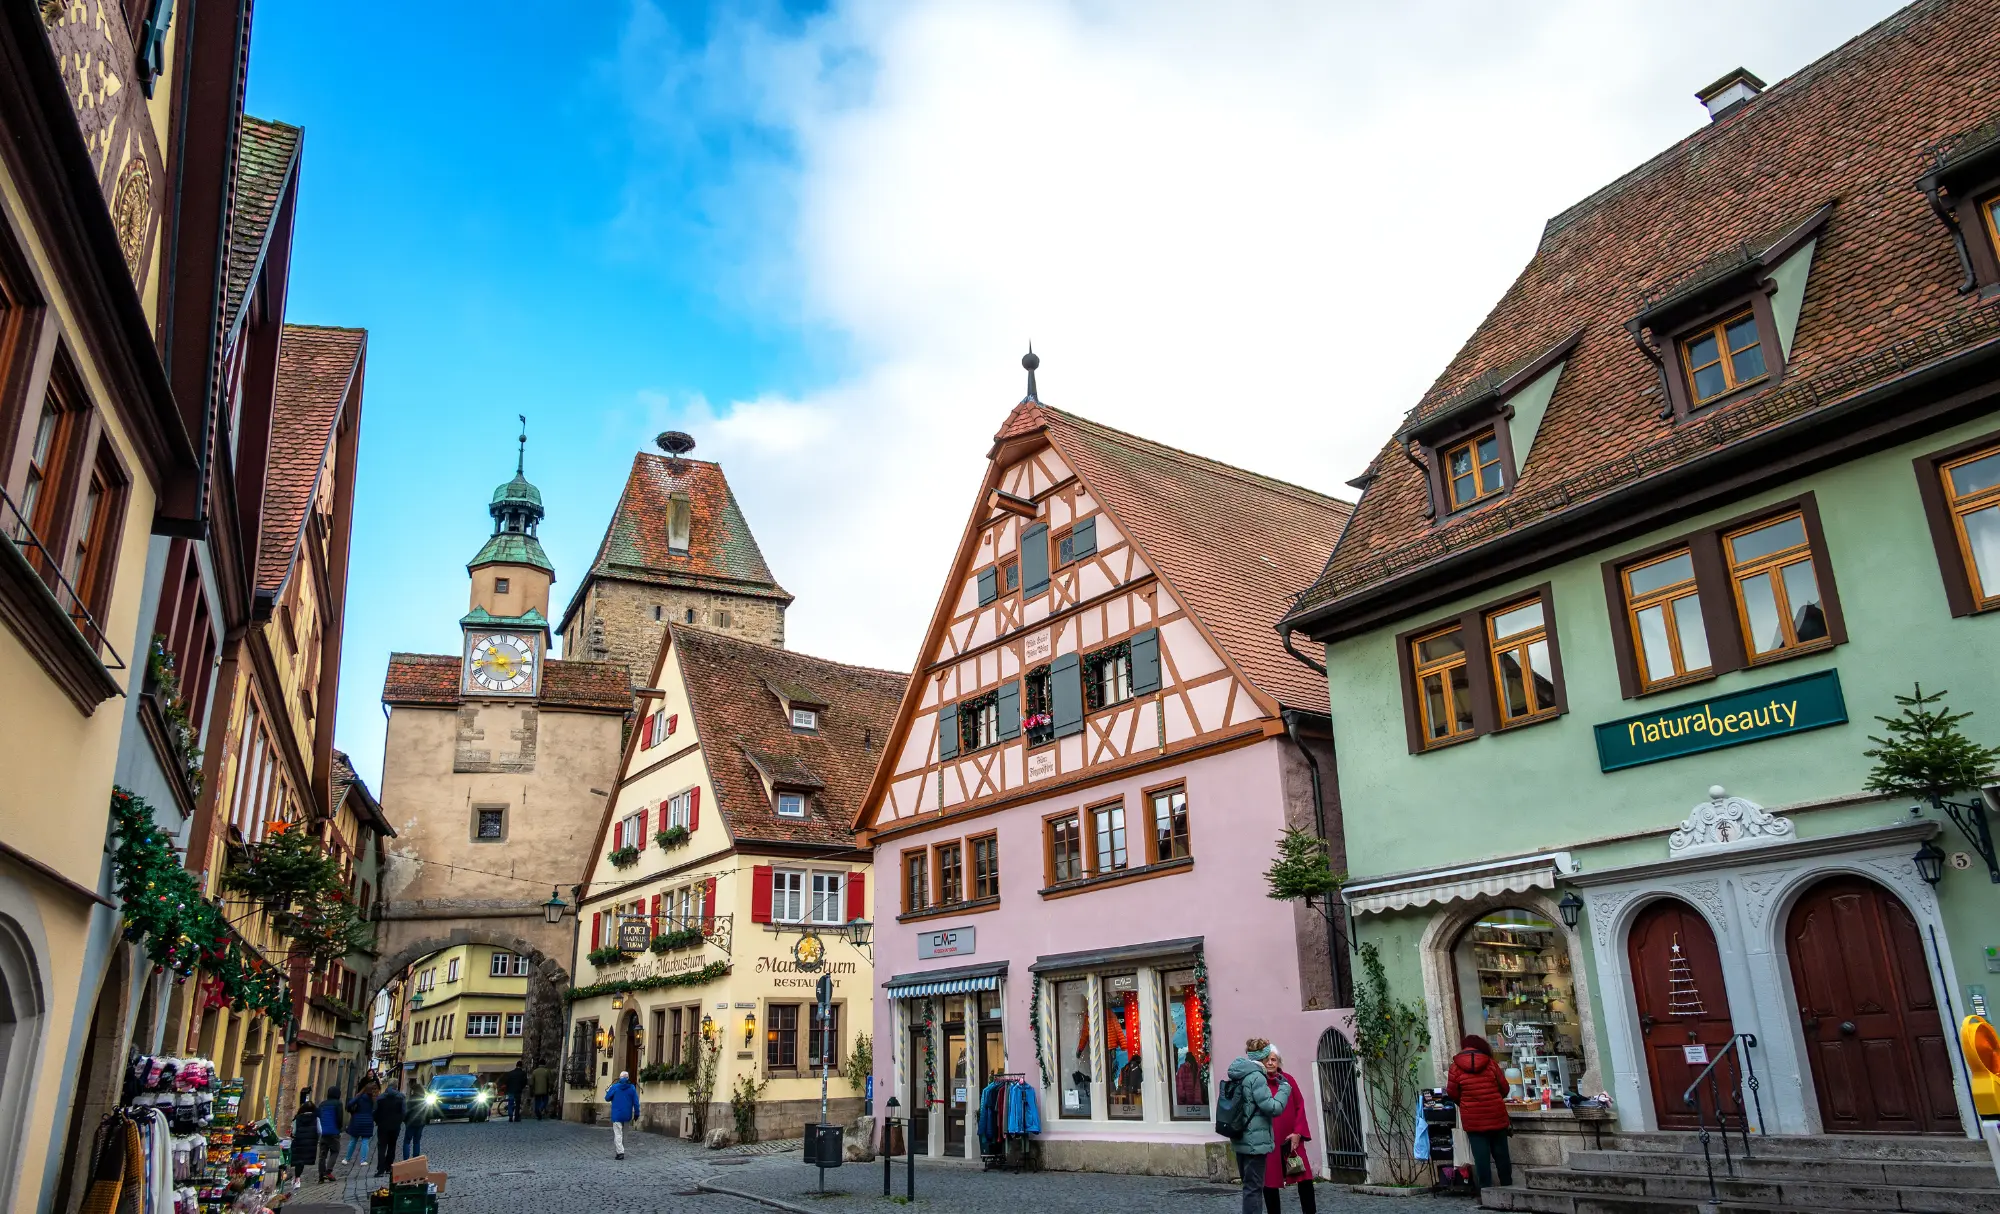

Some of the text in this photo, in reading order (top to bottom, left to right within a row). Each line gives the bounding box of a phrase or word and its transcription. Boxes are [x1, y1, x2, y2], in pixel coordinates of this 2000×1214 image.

[1628, 700, 1797, 746] naturabeauty
[1955, 855, 1967, 868] 5
[624, 926, 646, 935] HOTEL
[623, 935, 647, 943] MARKUS
[627, 941, 643, 949] TURM
[933, 932, 957, 947] CMP
[630, 961, 653, 980] Hotel
[656, 953, 706, 975] Markusturm
[755, 956, 857, 974] Marksturm
[774, 978, 841, 988] RESTAUNT
